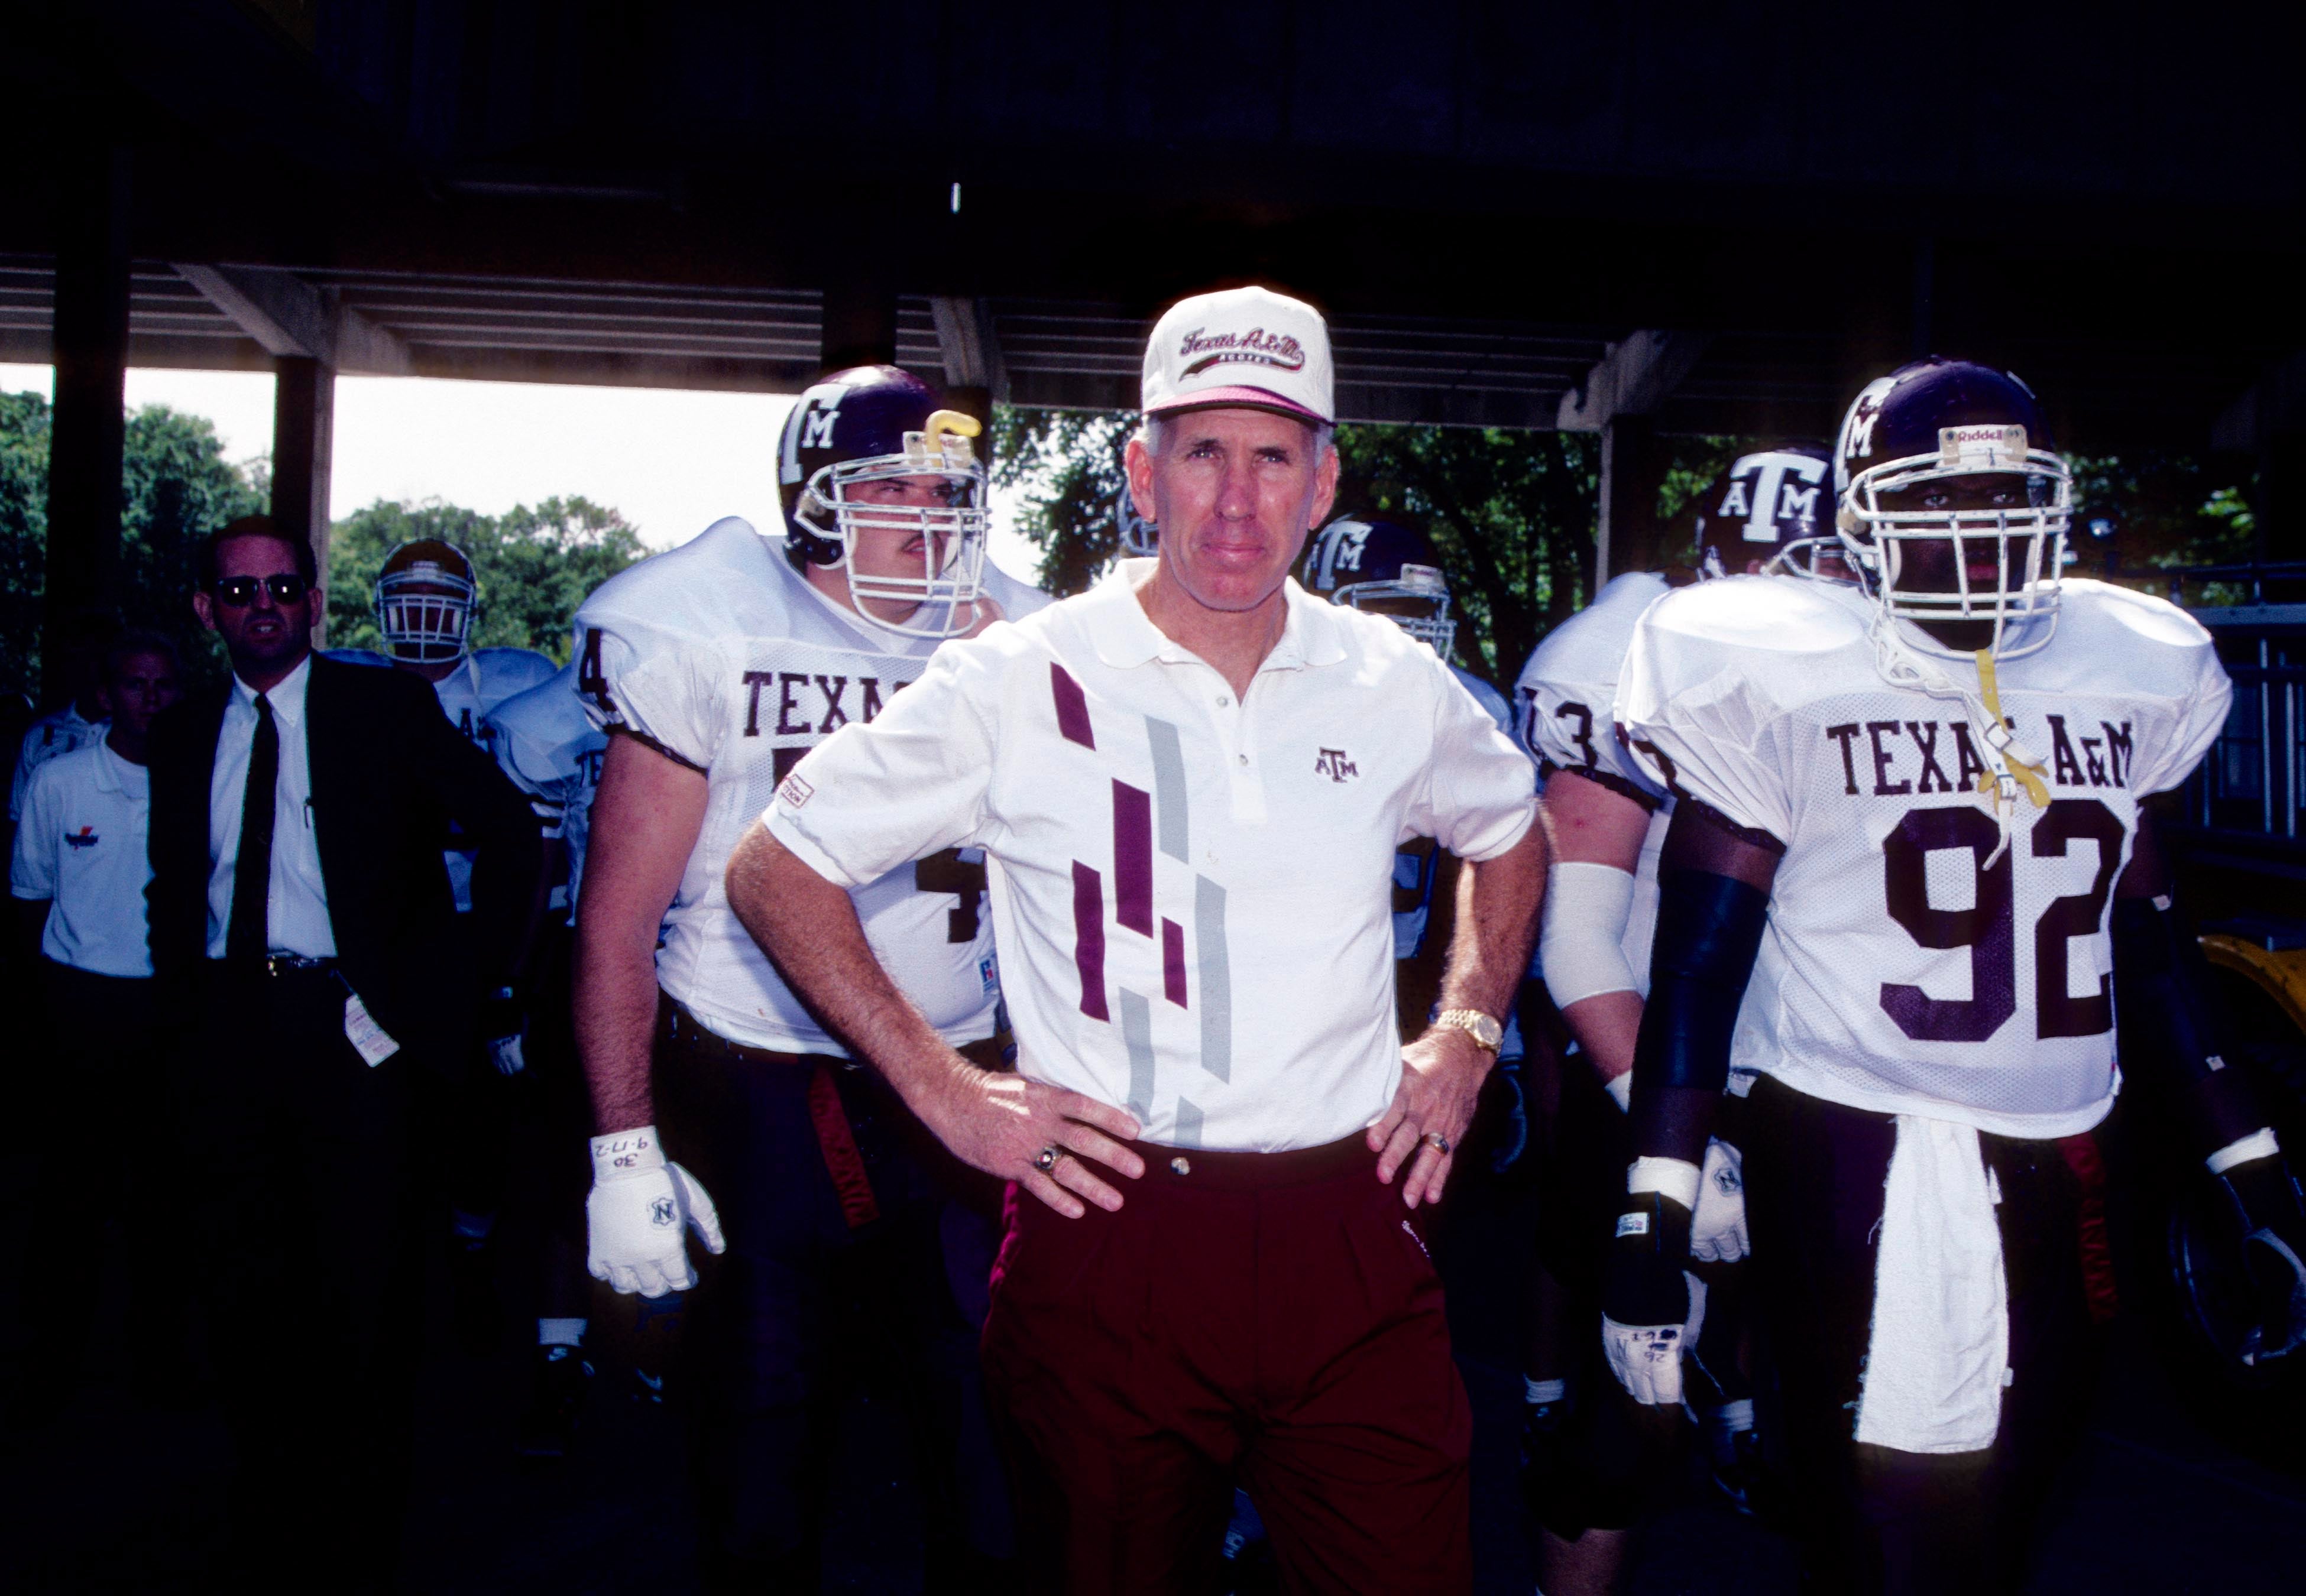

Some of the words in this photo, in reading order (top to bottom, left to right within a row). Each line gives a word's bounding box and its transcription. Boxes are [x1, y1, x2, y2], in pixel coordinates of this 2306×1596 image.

[1179, 327, 1238, 356] Texas
[1958, 429, 2003, 443] Riddell
[1718, 452, 1828, 543] ATM
[741, 671, 915, 737] TEXA
[1314, 747, 1359, 783] ATM
[1826, 717, 2016, 796] TEXA
[2046, 713, 2132, 789] A&M
[1879, 798, 2128, 1043] 92
